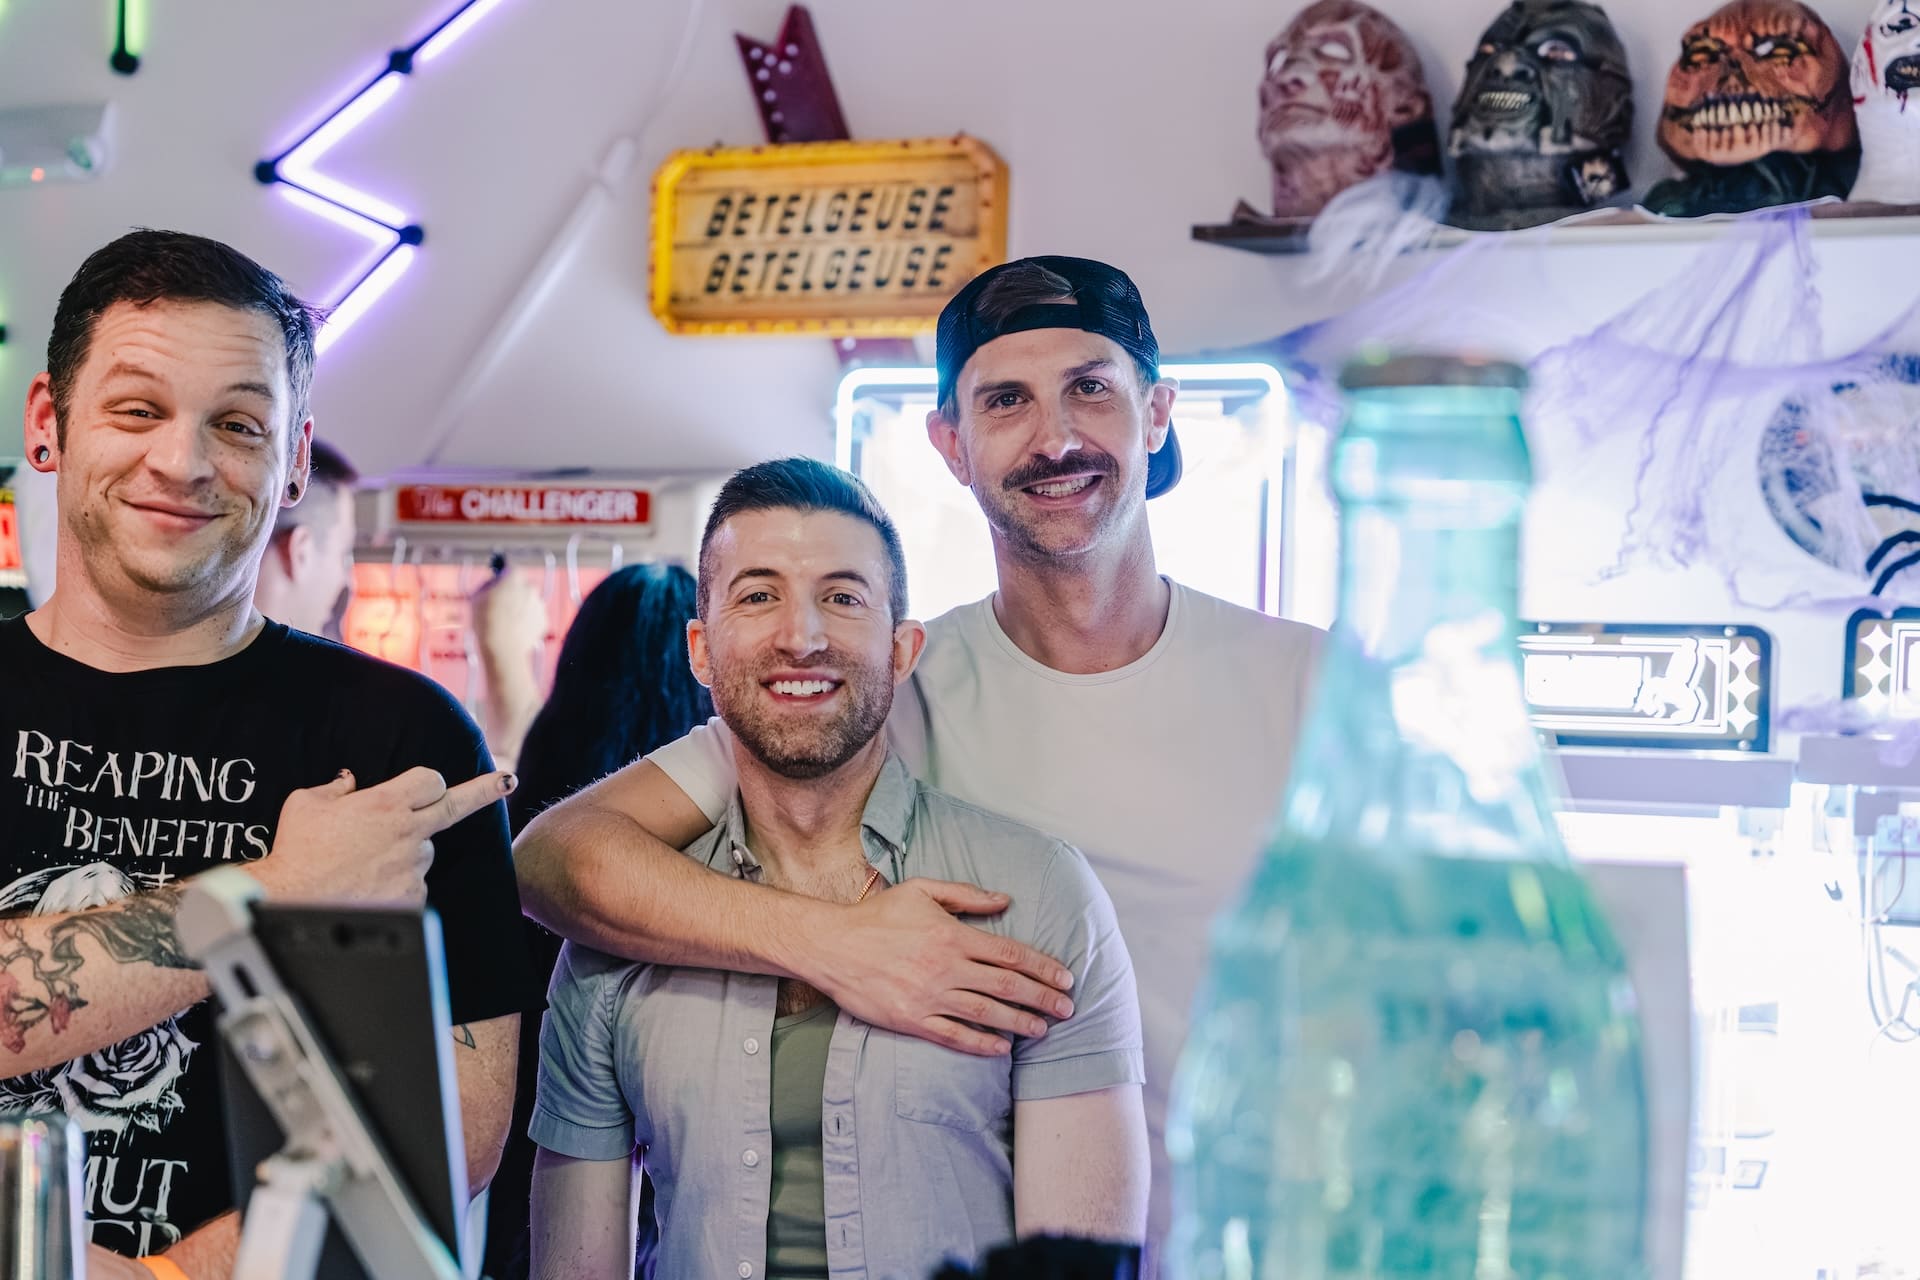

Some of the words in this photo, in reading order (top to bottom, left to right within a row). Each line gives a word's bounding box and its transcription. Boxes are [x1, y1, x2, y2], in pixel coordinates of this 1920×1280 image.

[706, 186, 955, 237] BETELGEUSE
[705, 246, 953, 293] BETELGEUSE
[460, 488, 639, 521] CHALLENGER
[12, 729, 257, 803] REAPING
[63, 805, 270, 861] BENEFITS
